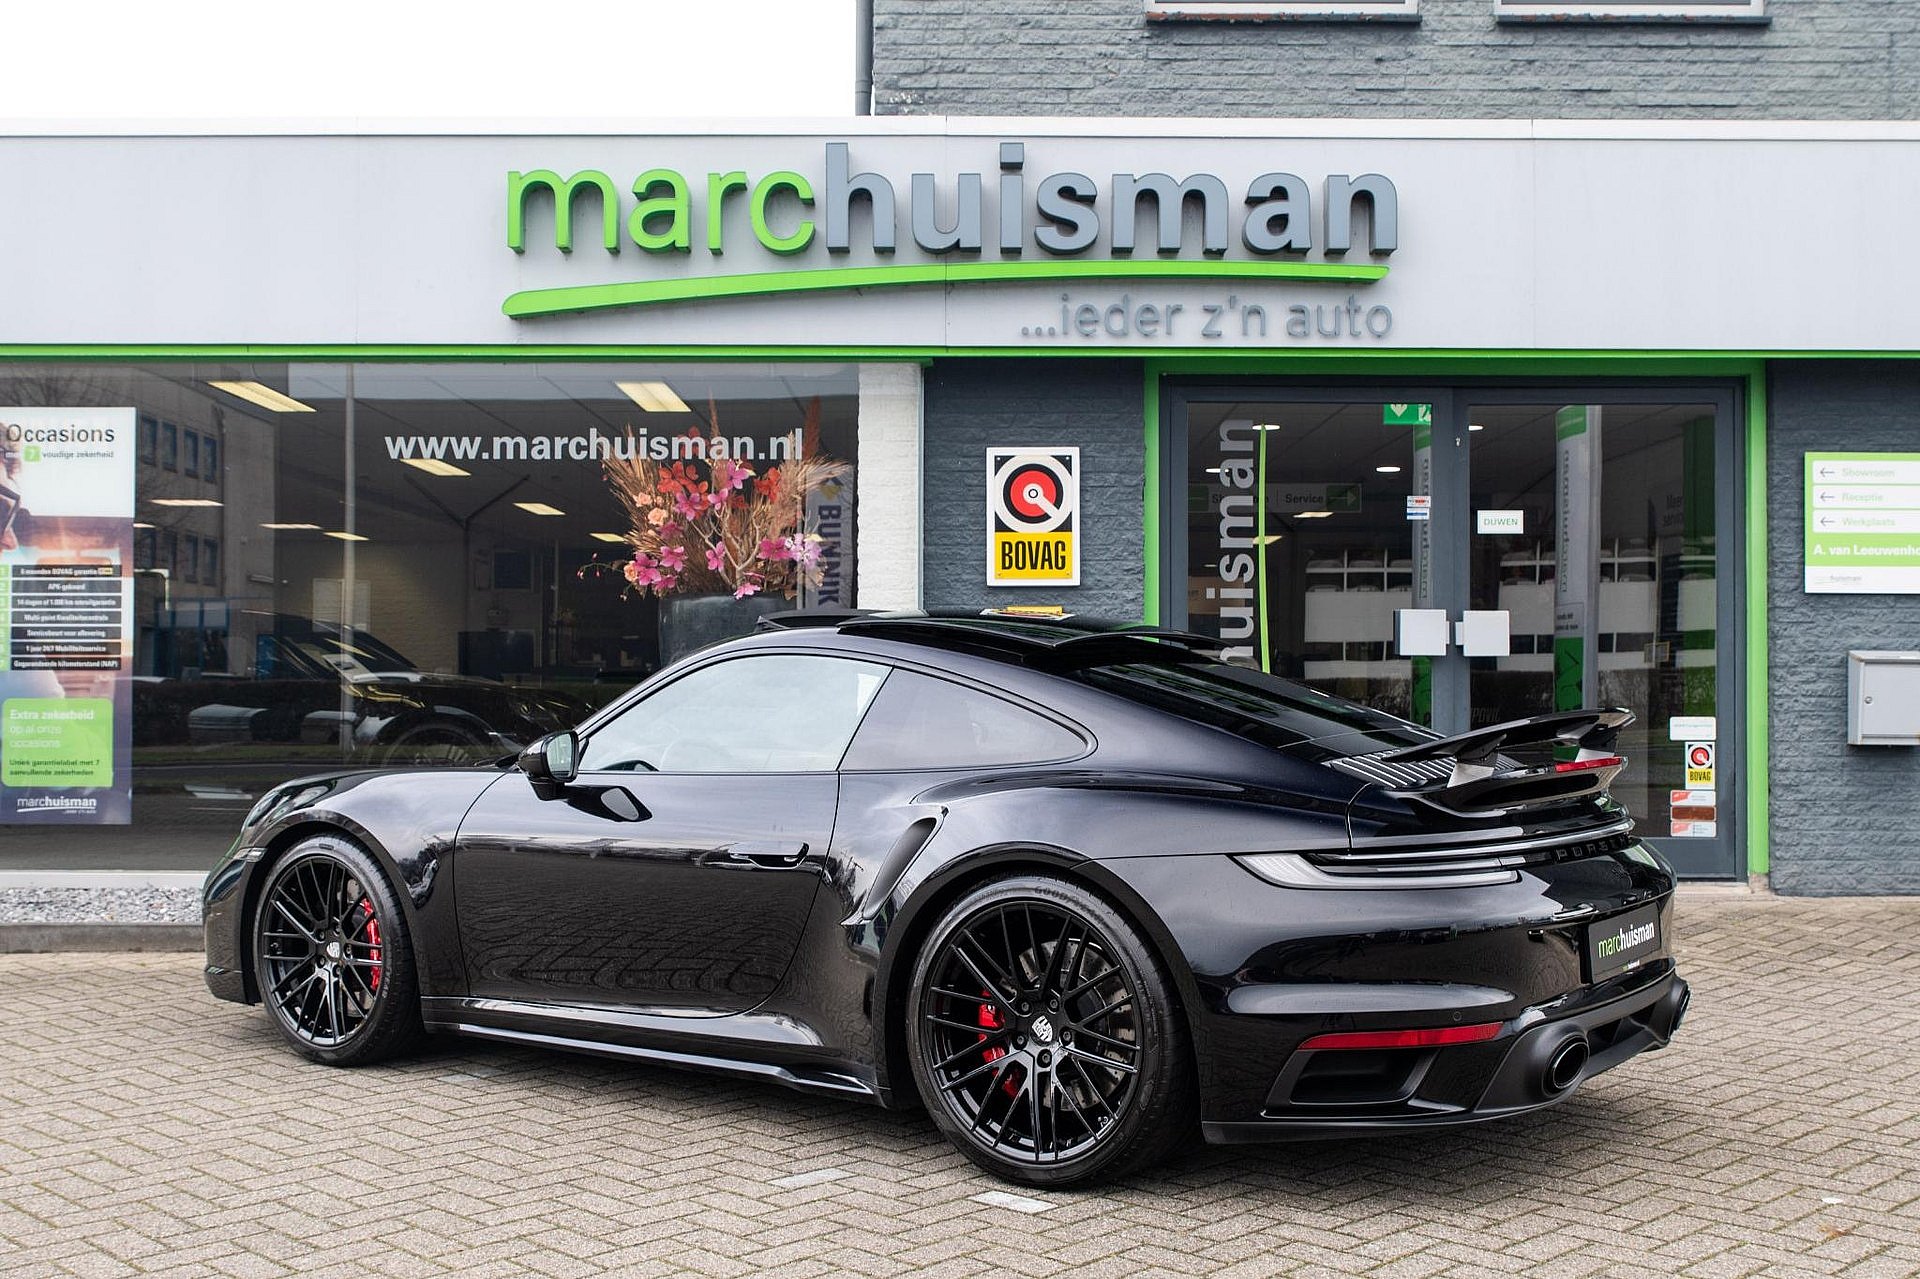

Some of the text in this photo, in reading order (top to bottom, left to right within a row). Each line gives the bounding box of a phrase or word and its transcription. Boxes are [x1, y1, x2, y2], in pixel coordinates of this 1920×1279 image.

[507, 142, 1398, 257] marchuisman
[1020, 293, 1394, 338] ...ieder z'n auto
[7, 424, 115, 442] Occasions
[384, 427, 803, 461] www.marchuisman.nl
[76, 451, 114, 459] zekerheid
[1285, 493, 1324, 505] Service
[1483, 517, 1519, 527] DUWEN
[1001, 540, 1067, 571] BOVAG
[1813, 543, 1826, 556] A.
[1829, 545, 1850, 556] van
[10, 709, 94, 720] Extra zekerheid
[1689, 770, 1711, 782] BOVAG
[17, 796, 97, 807] marchuisman
[1598, 922, 1655, 958] marchuisman
